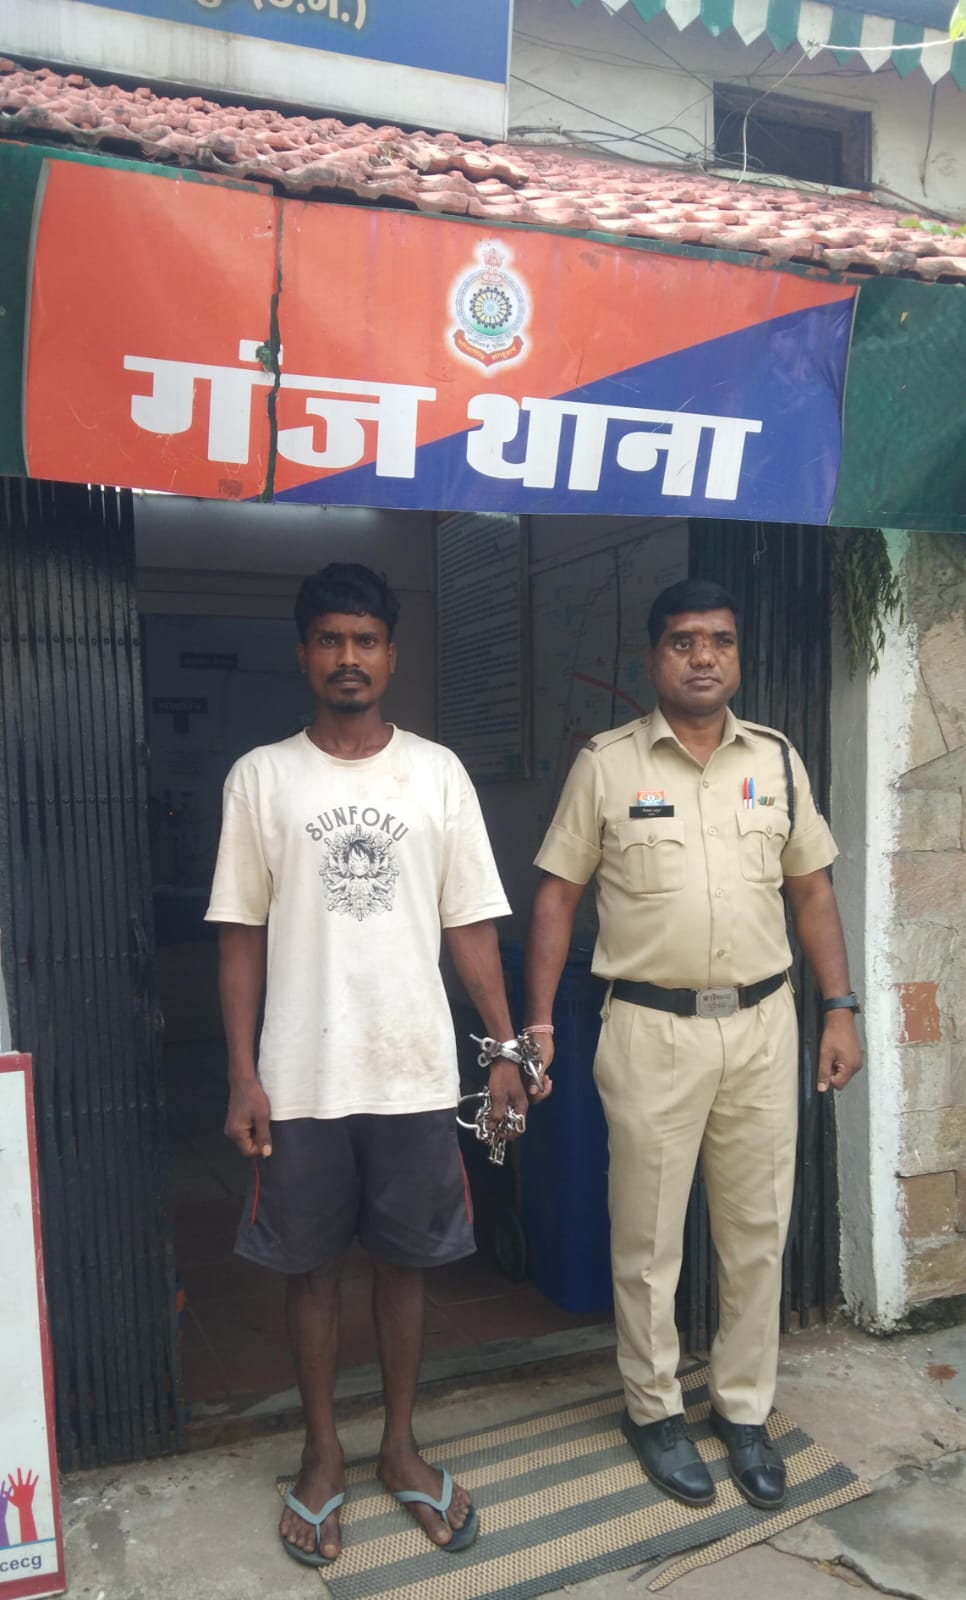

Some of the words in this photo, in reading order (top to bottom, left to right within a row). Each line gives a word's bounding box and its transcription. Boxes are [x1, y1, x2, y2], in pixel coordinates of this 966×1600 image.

[123, 340, 437, 479] गंज
[466, 393, 763, 500] थाना
[305, 806, 409, 841] SUNFOKU
